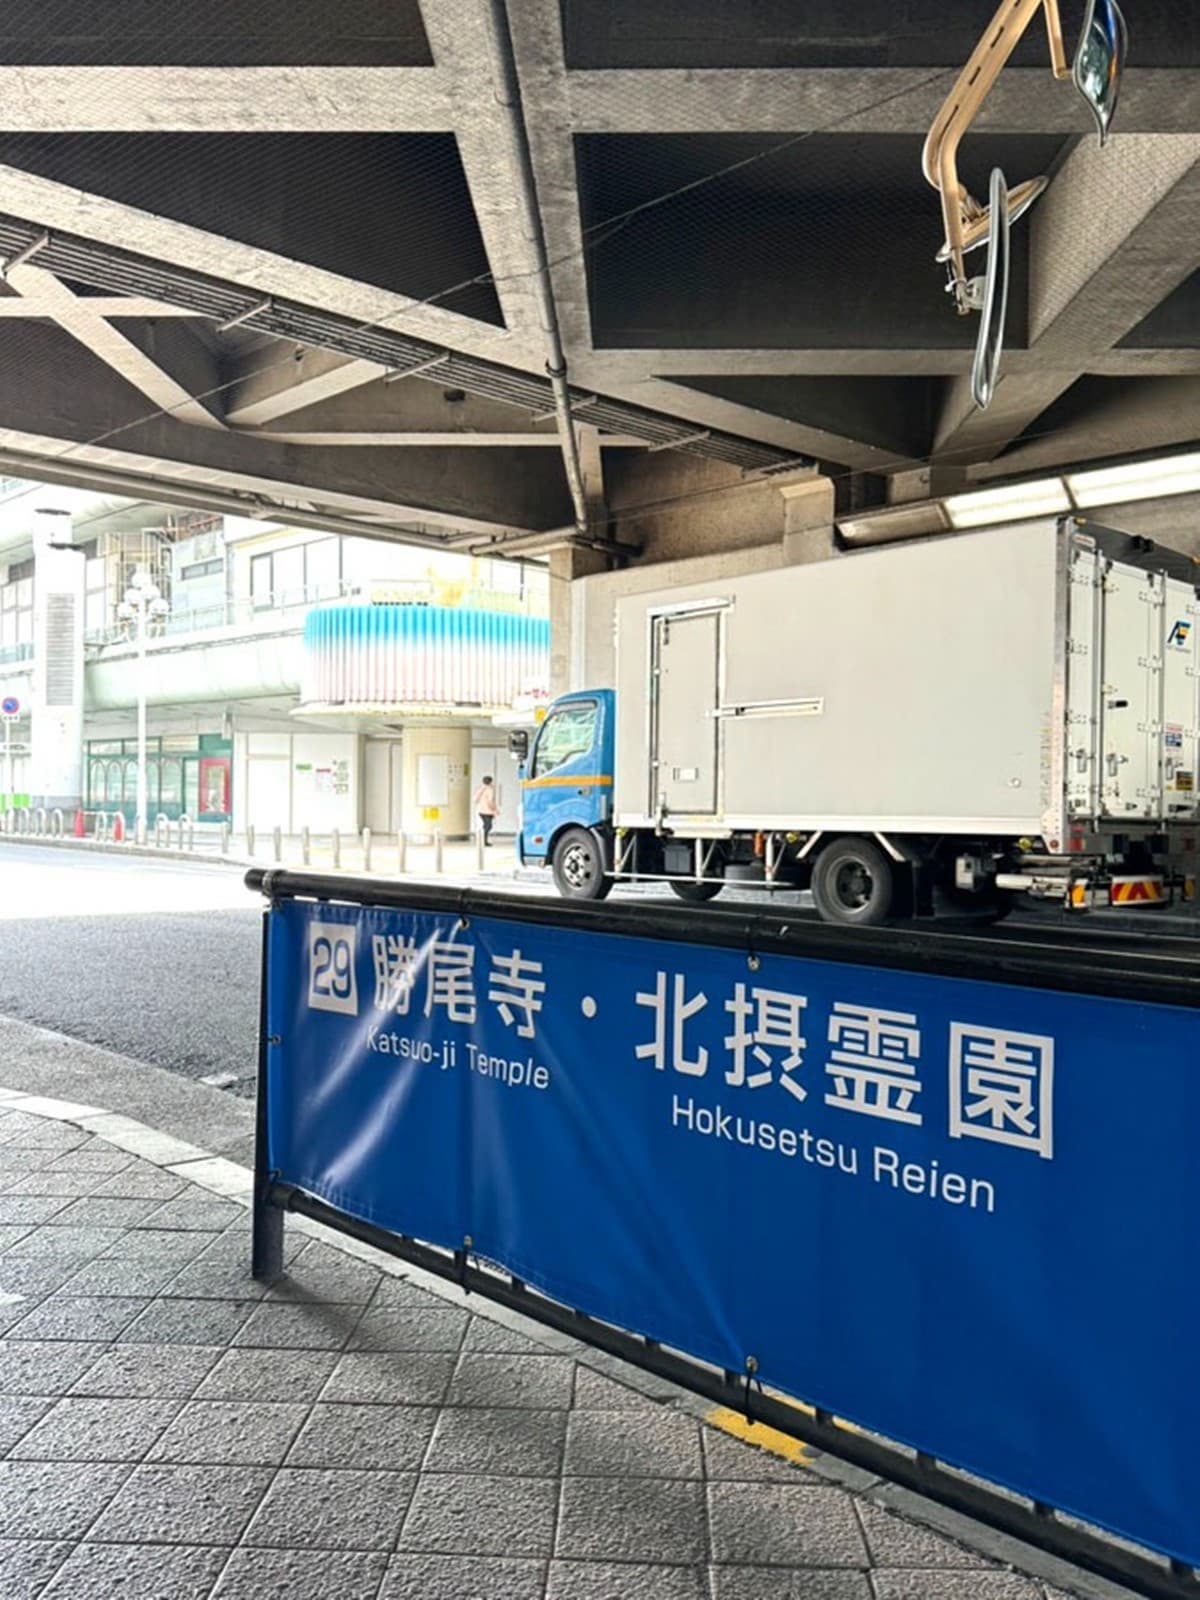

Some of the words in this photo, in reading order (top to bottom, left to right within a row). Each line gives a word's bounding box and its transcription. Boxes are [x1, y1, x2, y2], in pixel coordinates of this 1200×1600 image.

[312, 936, 352, 1000] 29
[366, 1025, 456, 1070] Katsuo-ji
[465, 1042, 550, 1090] Temple
[672, 1094, 858, 1175] Hokusetsu
[873, 1146, 995, 1213] Reien
